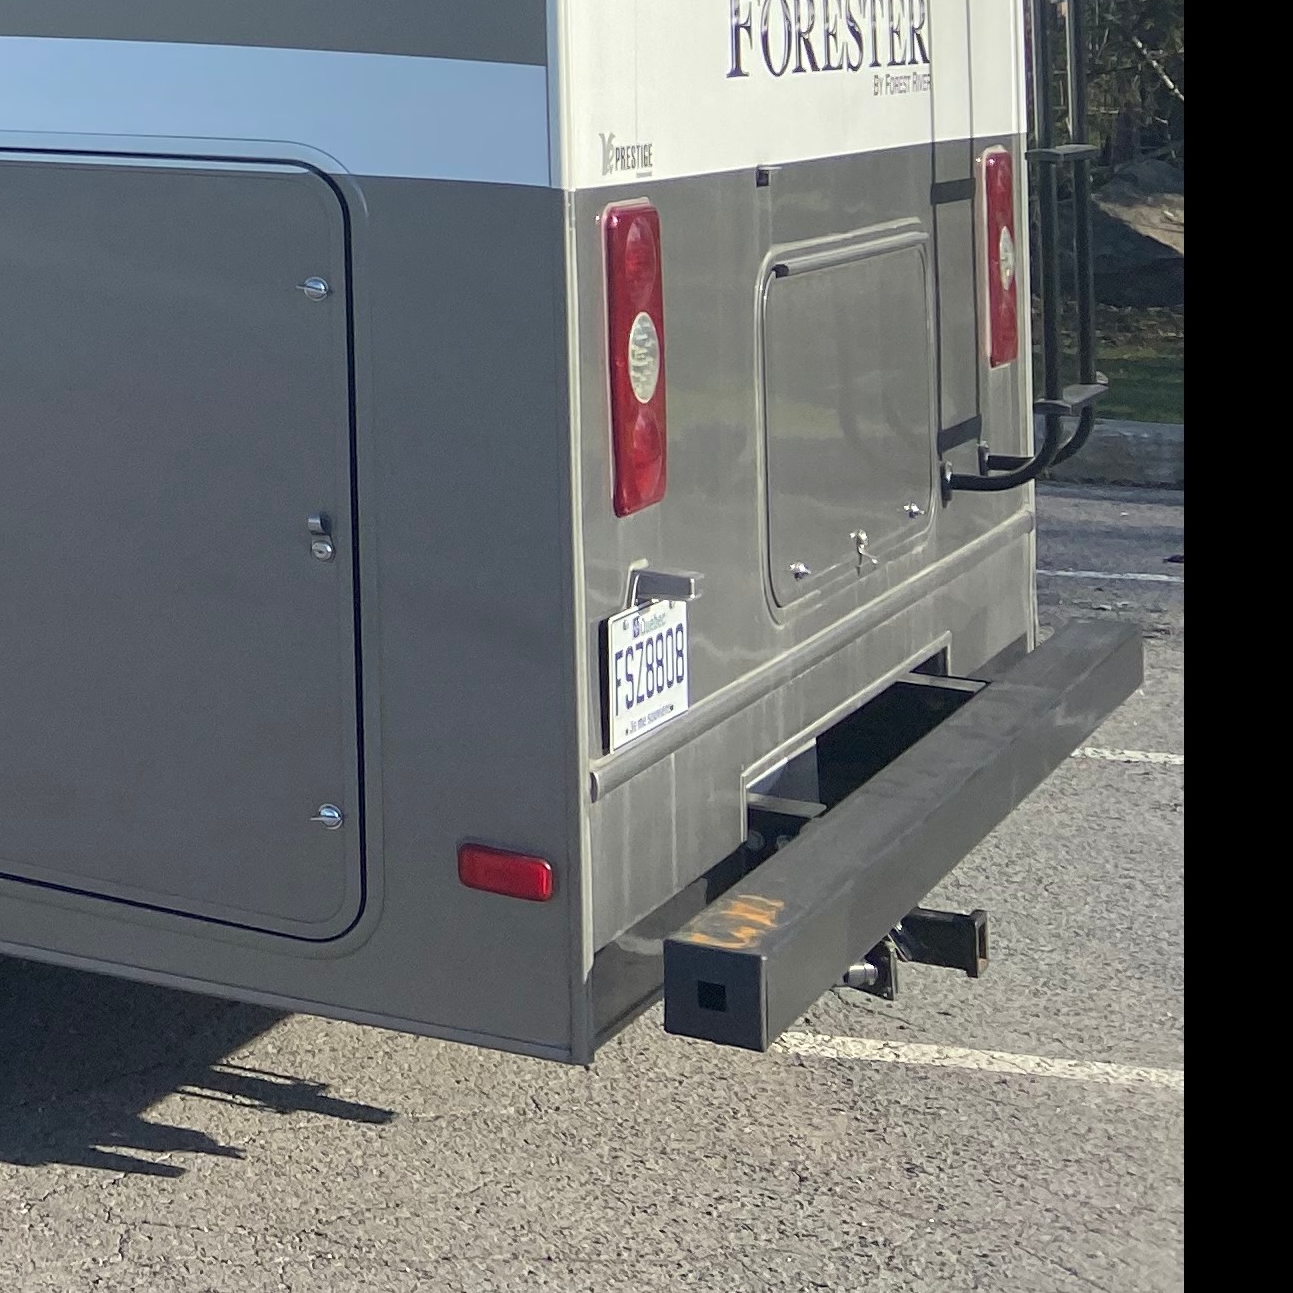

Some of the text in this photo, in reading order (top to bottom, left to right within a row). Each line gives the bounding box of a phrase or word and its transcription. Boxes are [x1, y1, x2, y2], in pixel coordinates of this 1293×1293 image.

[873, 74, 884, 96] BY
[885, 73, 910, 95] FOREST
[615, 143, 653, 171] PRESTIGE
[614, 622, 684, 716] FSZ8808
